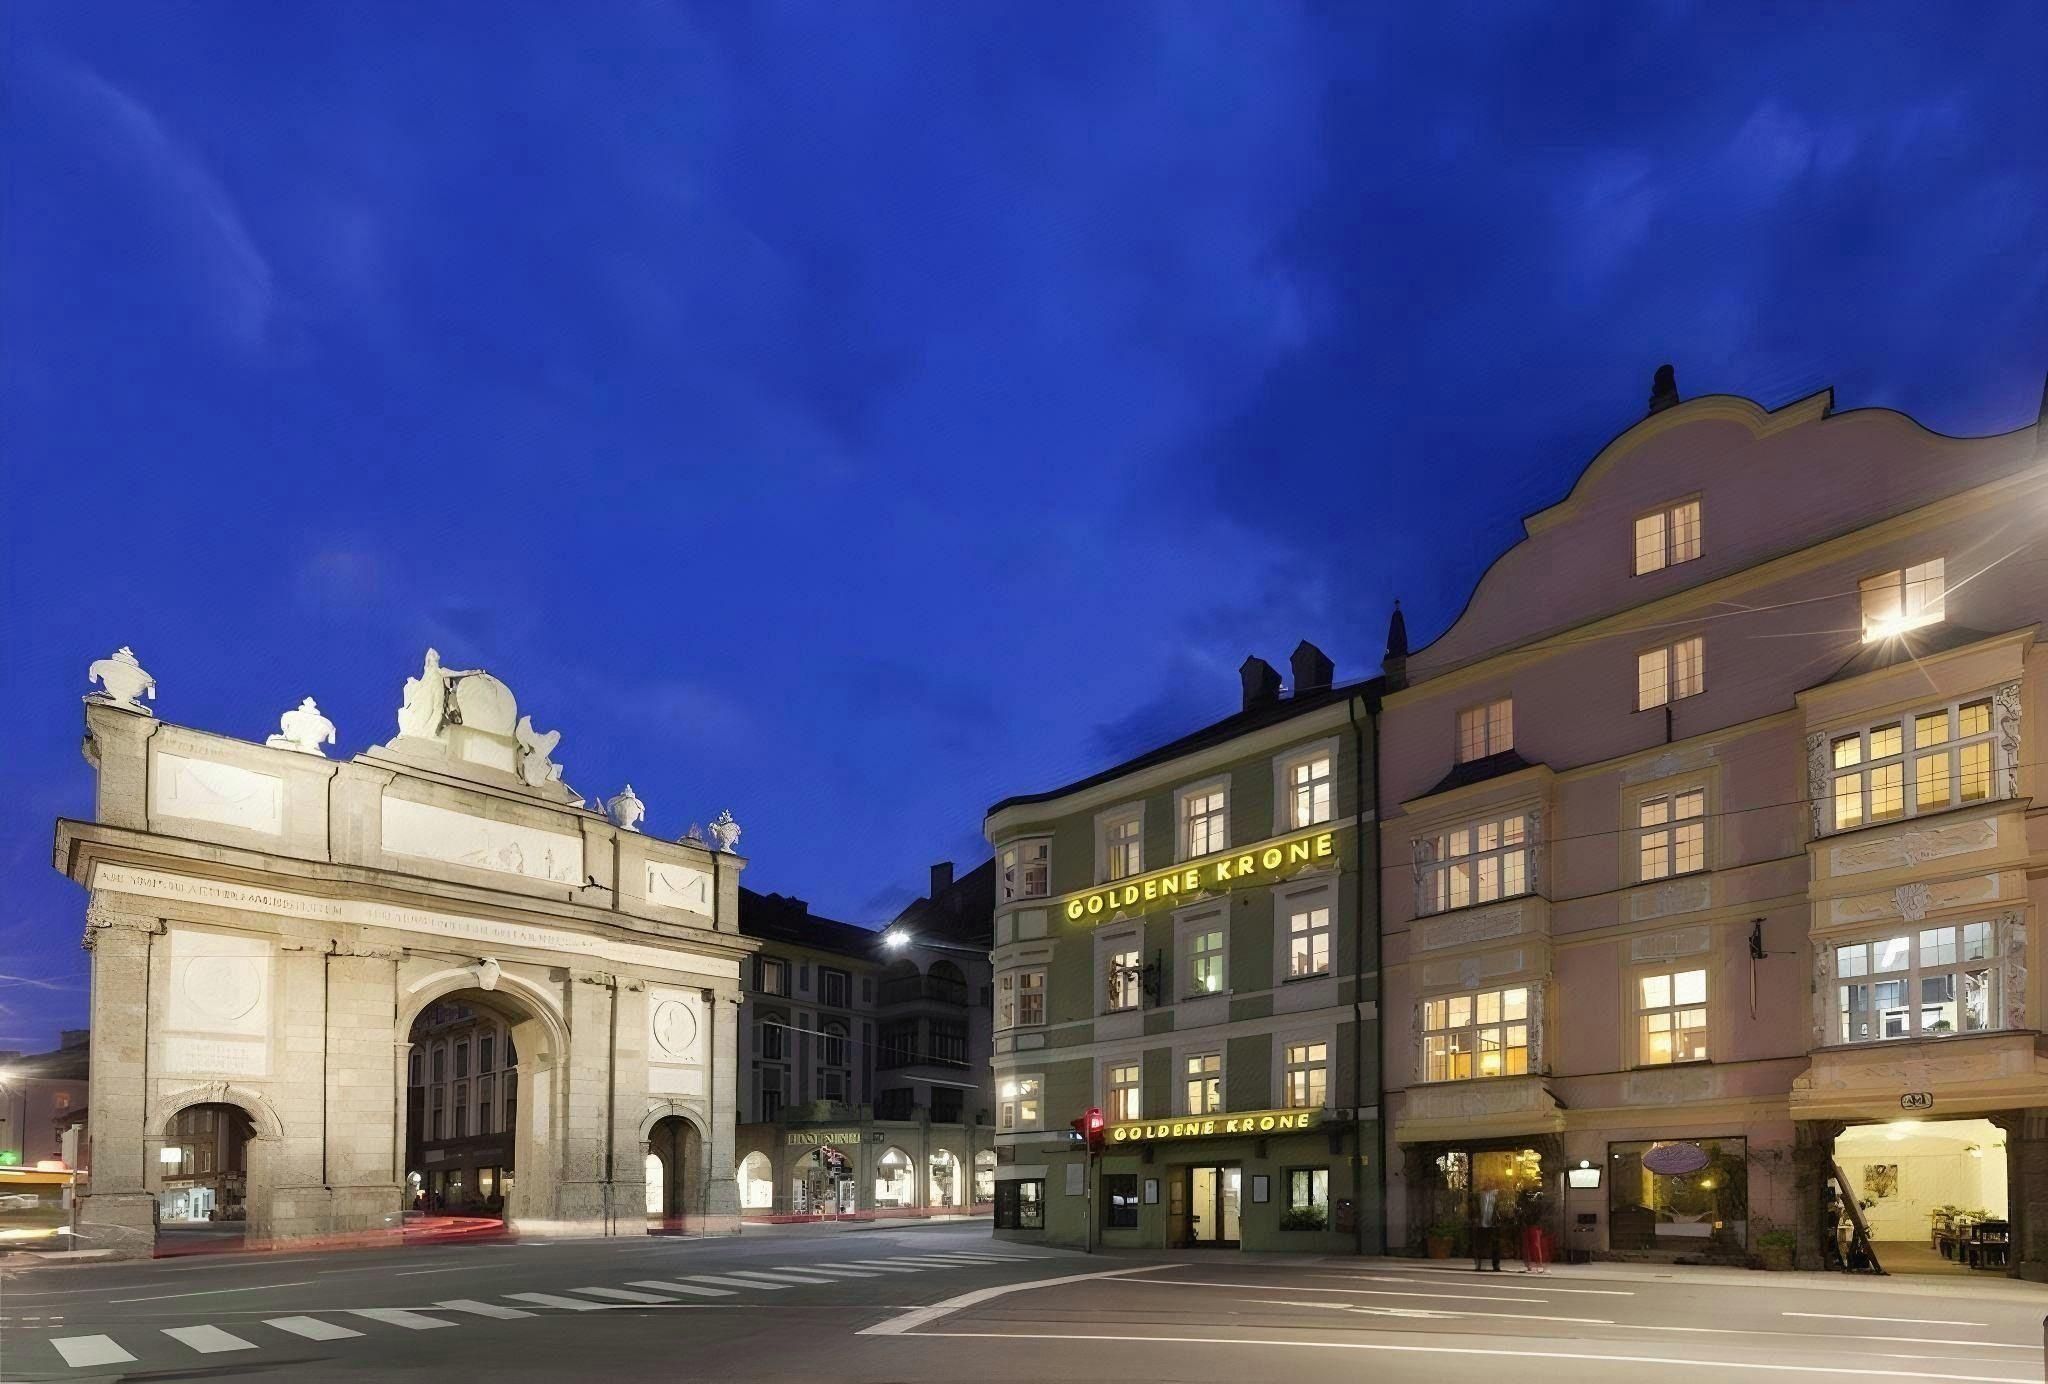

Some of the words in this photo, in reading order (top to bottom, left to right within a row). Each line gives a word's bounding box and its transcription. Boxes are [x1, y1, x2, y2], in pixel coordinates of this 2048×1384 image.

[1067, 869, 1200, 919] GOLDENE
[1216, 833, 1332, 881] KRONE
[1114, 1121, 1215, 1141] GOLDENE
[1226, 1113, 1309, 1133] KRONE
